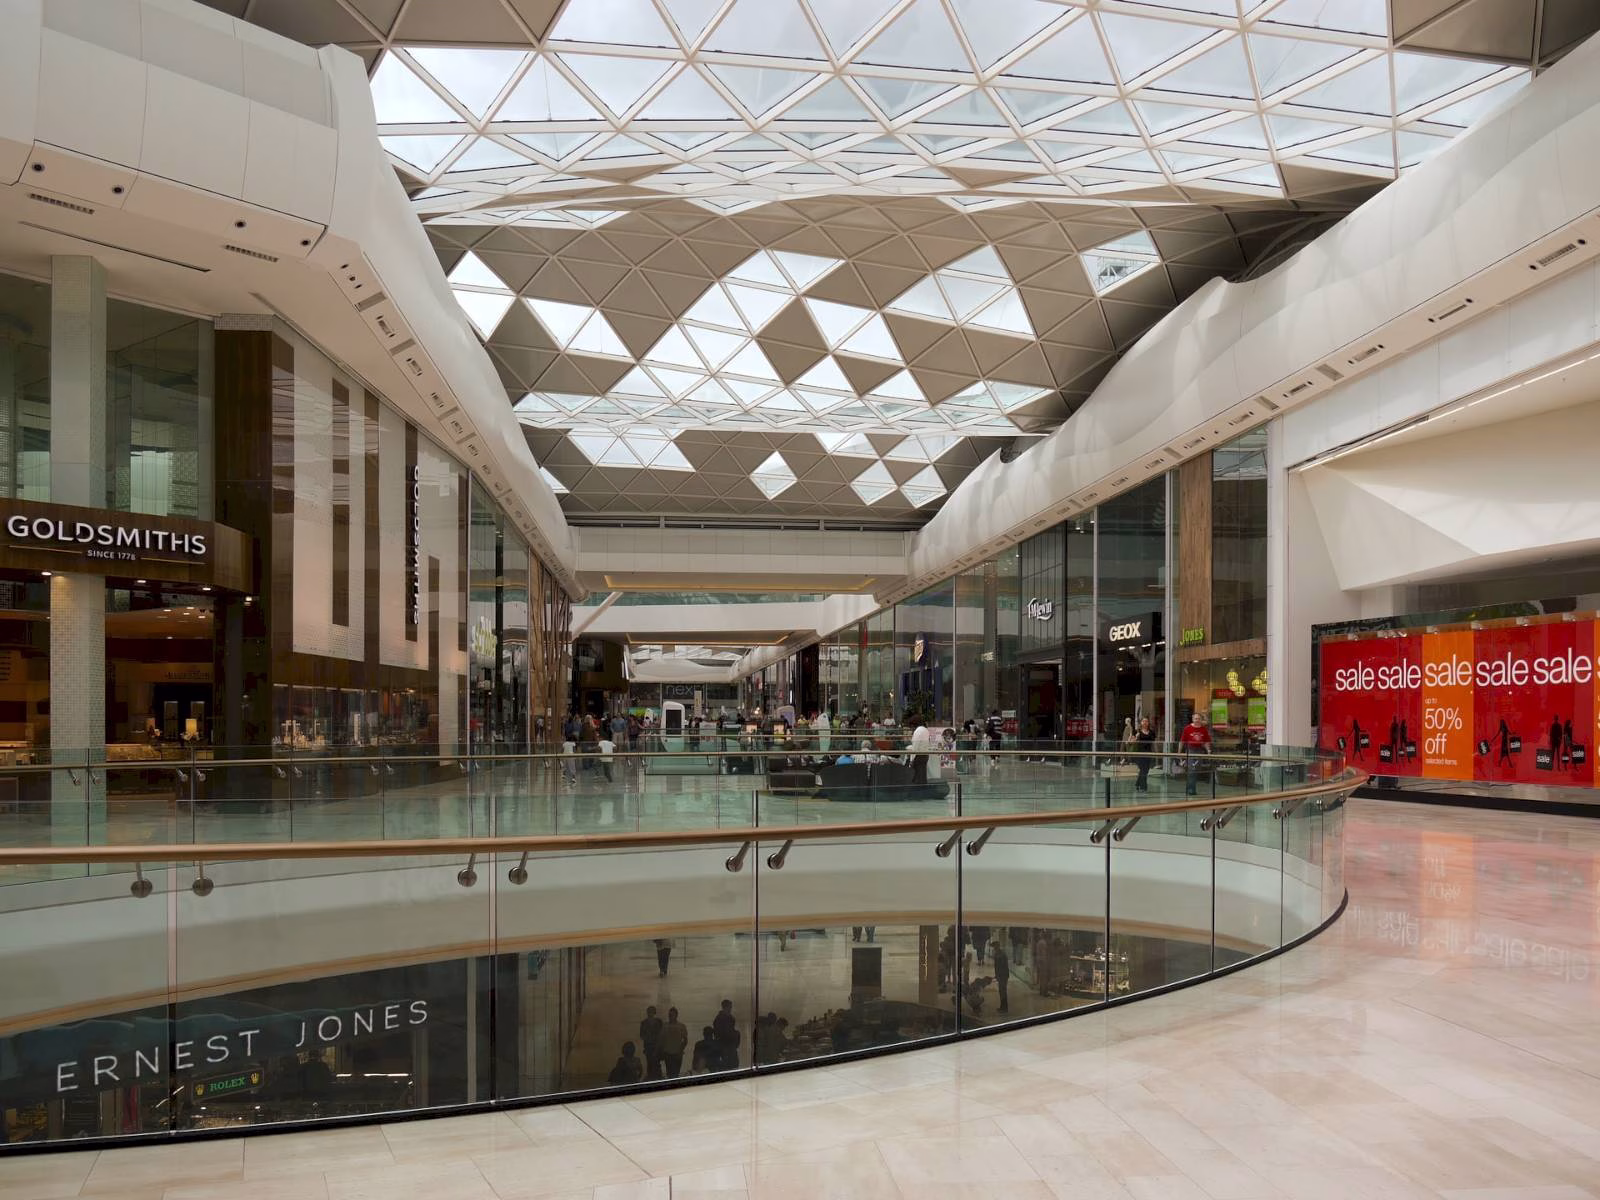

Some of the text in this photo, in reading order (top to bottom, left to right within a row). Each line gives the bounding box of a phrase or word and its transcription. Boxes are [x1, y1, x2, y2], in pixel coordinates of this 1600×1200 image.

[7, 515, 207, 555] GOLDSMITHS
[87, 549, 115, 560] SINCE
[1109, 621, 1141, 642] GEOX
[1335, 661, 1375, 691] sale
[1377, 658, 1421, 690] sale
[1424, 654, 1472, 687] sale
[1475, 652, 1529, 687] sale
[1533, 647, 1592, 685] sale
[1424, 707, 1463, 730] 50%
[1425, 733, 1447, 755] off
[57, 1000, 428, 1092] ERNEST JONES
[209, 1076, 246, 1092] ROLEX
